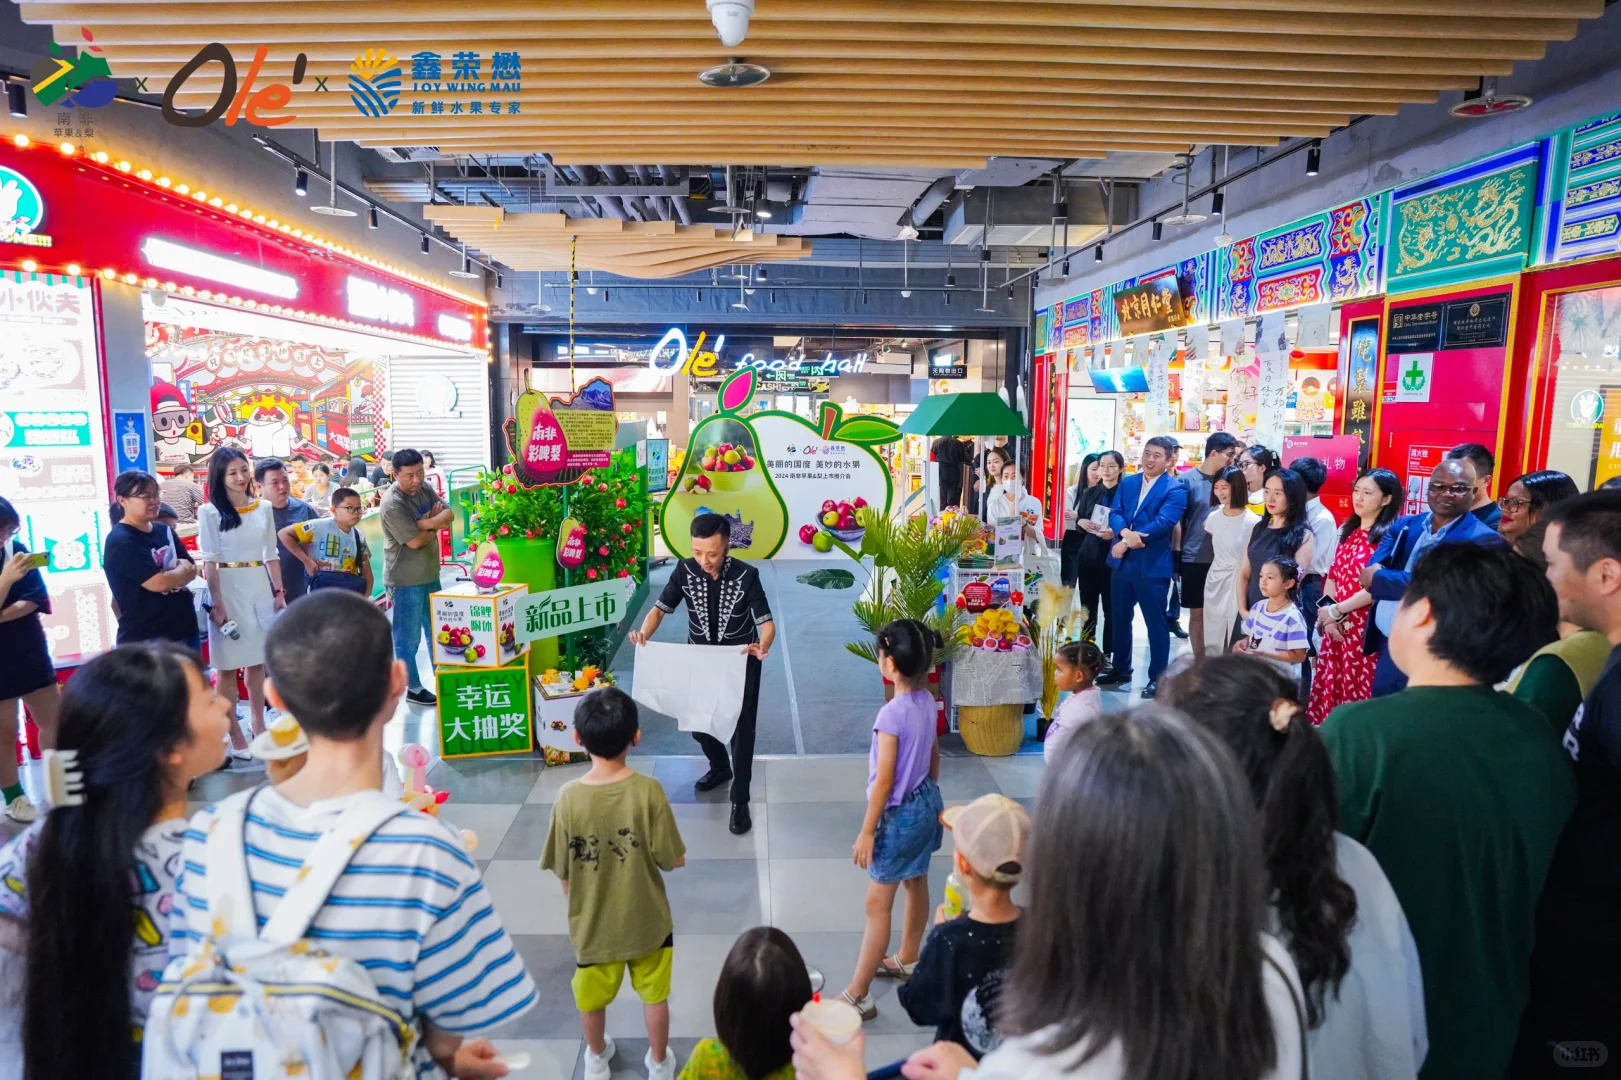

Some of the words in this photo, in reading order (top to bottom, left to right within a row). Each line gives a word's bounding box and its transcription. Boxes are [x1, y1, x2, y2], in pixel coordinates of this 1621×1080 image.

[1404, 311, 1438, 322] 中华老字号
[735, 352, 806, 373] food
[820, 352, 869, 373] hall
[532, 421, 558, 441] 南非
[527, 443, 563, 463] 彩啤梨
[1410, 449, 1429, 458] 消火栓
[767, 460, 811, 469] 美丽的国度
[816, 460, 860, 469] 美妙的水果
[525, 591, 617, 633] 新品上市
[456, 683, 512, 711] 幸运
[444, 712, 527, 743] 大抽奖
